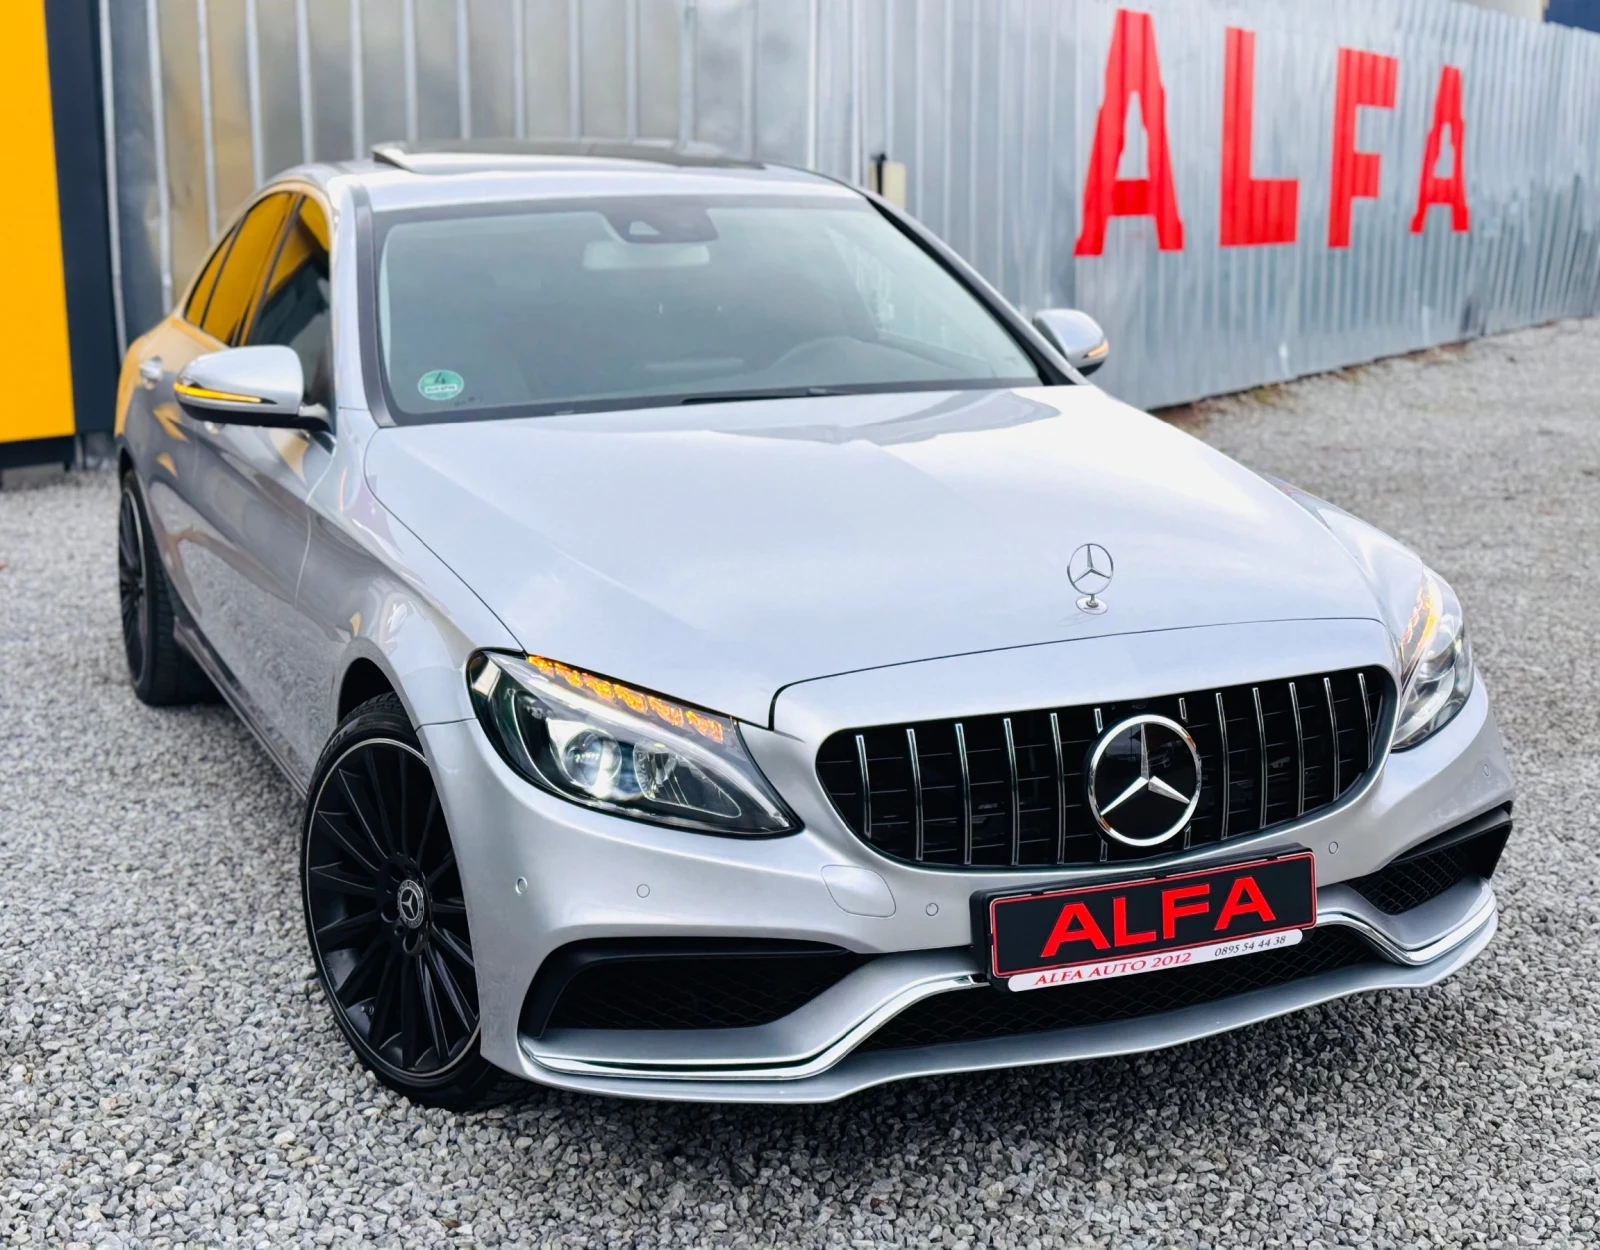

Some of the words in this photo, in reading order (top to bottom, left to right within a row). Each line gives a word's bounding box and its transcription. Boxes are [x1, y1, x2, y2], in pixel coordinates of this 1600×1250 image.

[1073, 8, 1470, 257] ALFA
[1041, 876, 1277, 958] ALFA
[1033, 969, 1083, 986] ALFA
[1088, 960, 1147, 978] AUTO
[1151, 952, 1192, 968] 2012
[1214, 944, 1241, 957] 0895
[1242, 942, 1255, 952] 54
[1257, 938, 1271, 948] 44
[1273, 935, 1287, 945] 38
